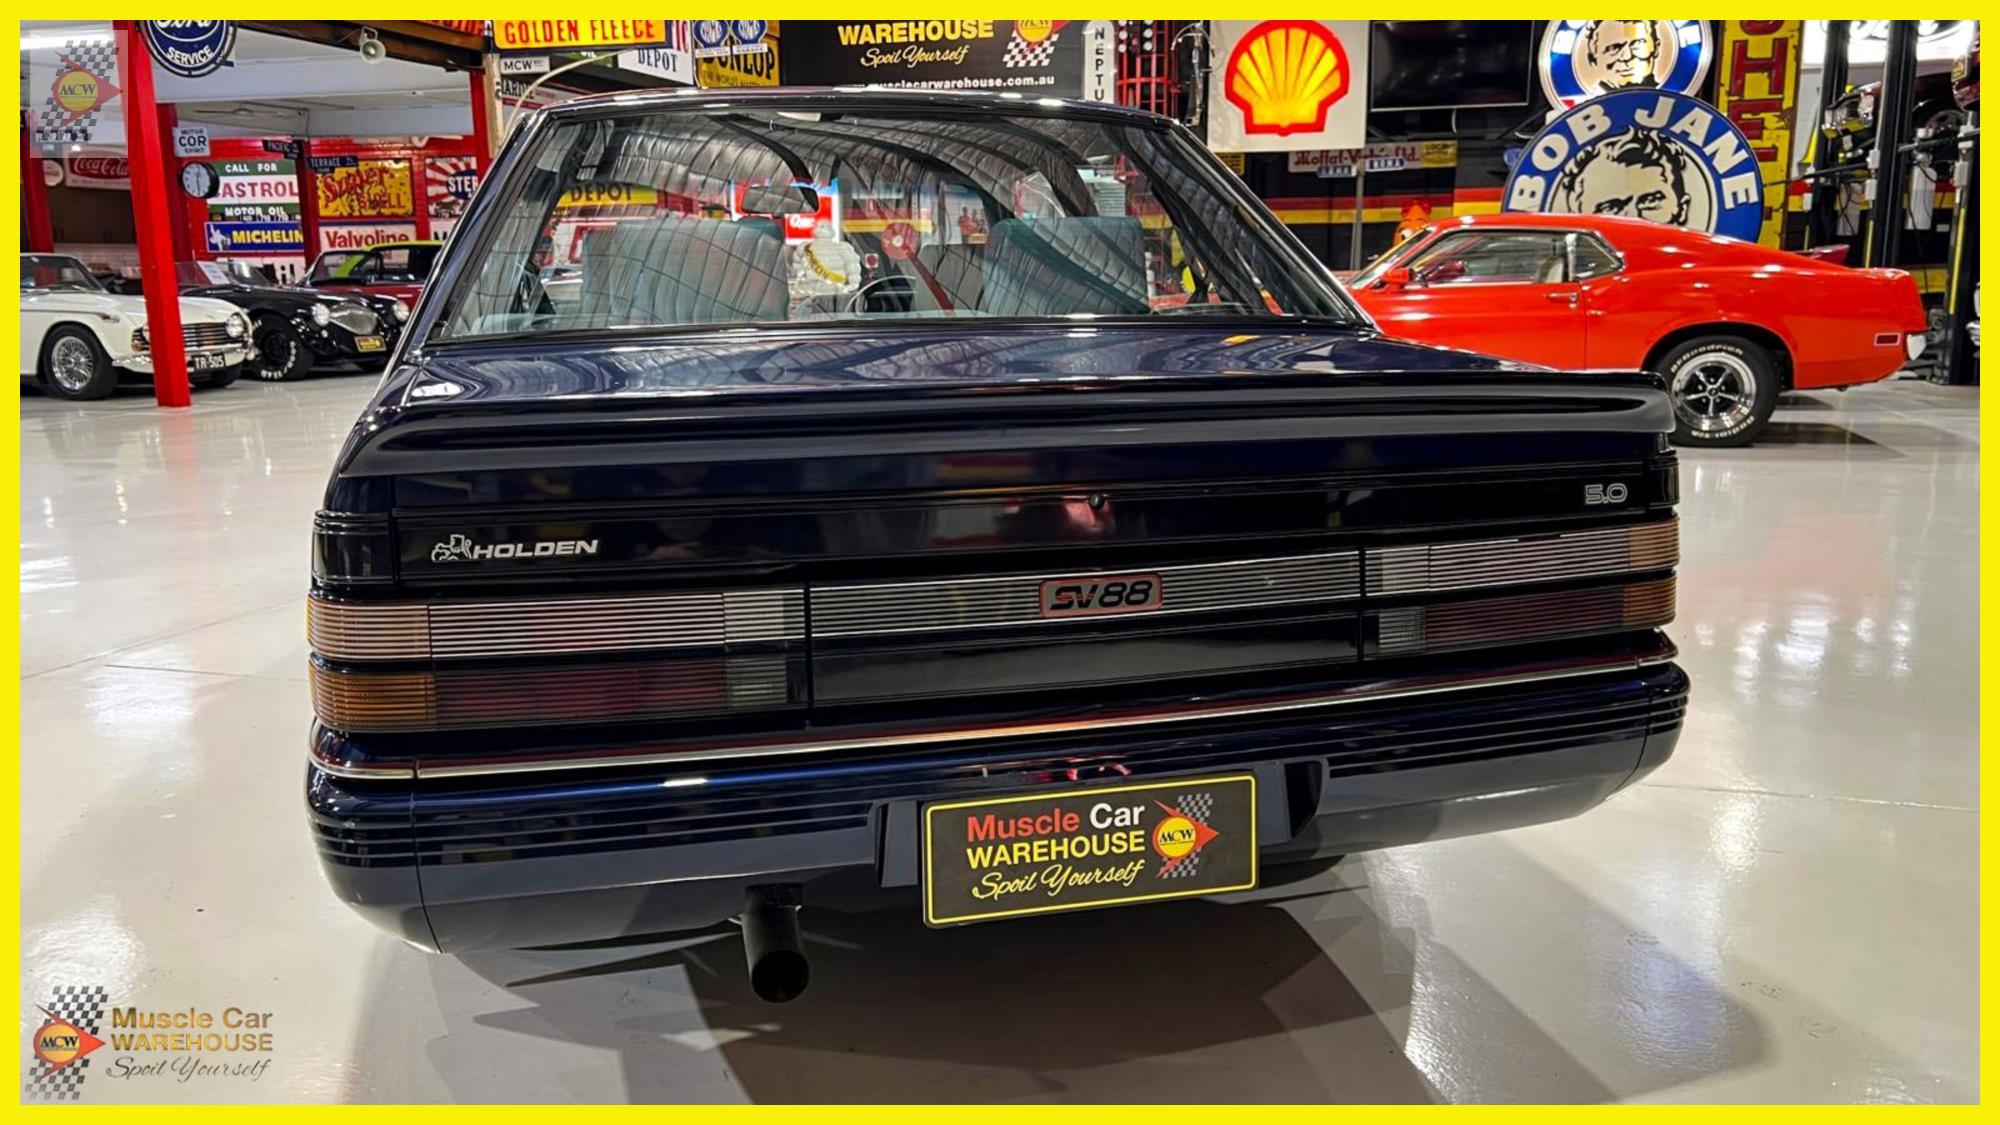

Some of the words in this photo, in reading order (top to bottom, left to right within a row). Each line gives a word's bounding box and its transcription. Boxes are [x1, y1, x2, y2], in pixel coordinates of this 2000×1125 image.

[504, 20, 579, 44] GOLDEN
[590, 20, 655, 41] FLEECE
[838, 20, 994, 46] WAREHOUSE
[166, 44, 214, 65] SERVICE
[503, 59, 532, 71] MCW
[638, 49, 678, 72] DEPOT
[860, 48, 902, 69] Spoil
[902, 44, 970, 69] Yourself
[178, 136, 207, 147] COR
[1508, 103, 1612, 213] BOB
[1634, 94, 1759, 211] JANE
[225, 162, 249, 173] CALL
[257, 162, 278, 172] FOR
[215, 181, 299, 198] ASTROL
[570, 183, 634, 202] DEPOT
[224, 207, 262, 217] MOTOR
[268, 206, 286, 216] OIL
[231, 231, 303, 244] MICHELIN
[325, 230, 409, 248] Valvoline
[193, 357, 225, 369] TR-505
[1584, 482, 1628, 505] 5.0
[472, 539, 599, 560] HOLDEN
[1049, 580, 1153, 610] SV88
[967, 807, 1080, 843] Muscle
[1089, 803, 1145, 830] Car
[1160, 829, 1194, 842] MCW
[966, 830, 1146, 870] WAREHOUSE
[971, 872, 1037, 900] Spoil
[1040, 859, 1145, 897] Yourself
